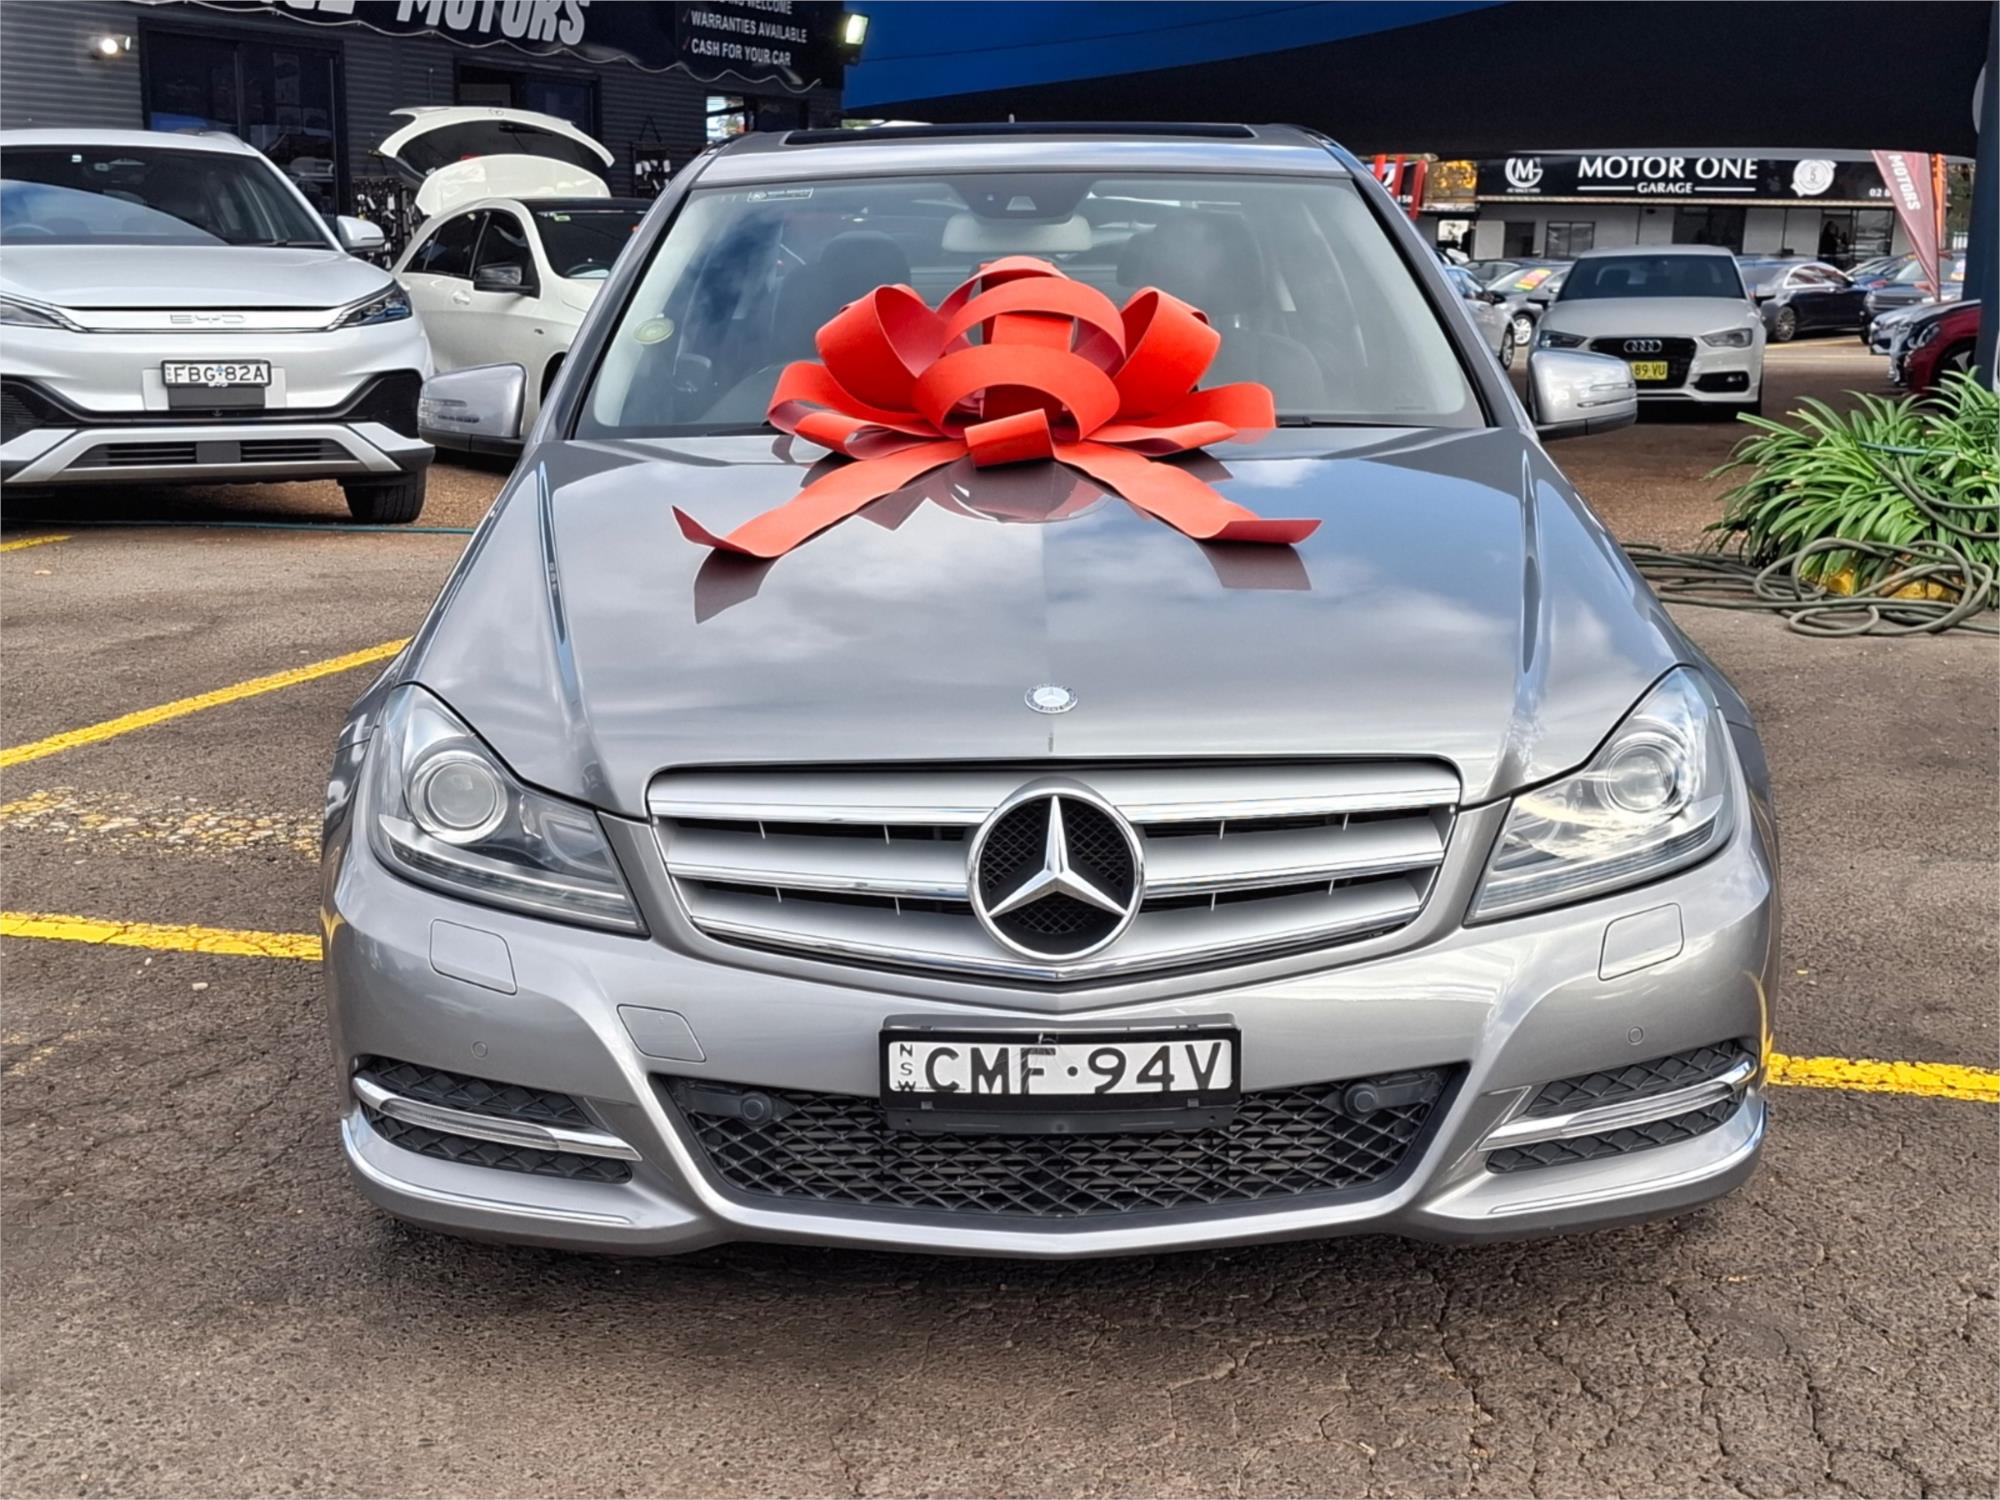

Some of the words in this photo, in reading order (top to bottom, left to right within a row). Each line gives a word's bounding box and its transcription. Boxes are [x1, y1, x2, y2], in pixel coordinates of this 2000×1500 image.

[396, 1, 590, 45] MOTORS
[691, 10, 757, 35] WARRANTIES
[758, 22, 808, 43] AVAILABLE
[691, 38, 720, 56] CASH
[722, 43, 743, 59] FOR
[745, 46, 771, 63] YOUR
[772, 50, 791, 66] CAR
[1577, 156, 1686, 179] MOTOR
[1695, 158, 1759, 180] ONE
[1888, 154, 1921, 210] MOTORS
[1637, 182, 1693, 194] GARAGE
